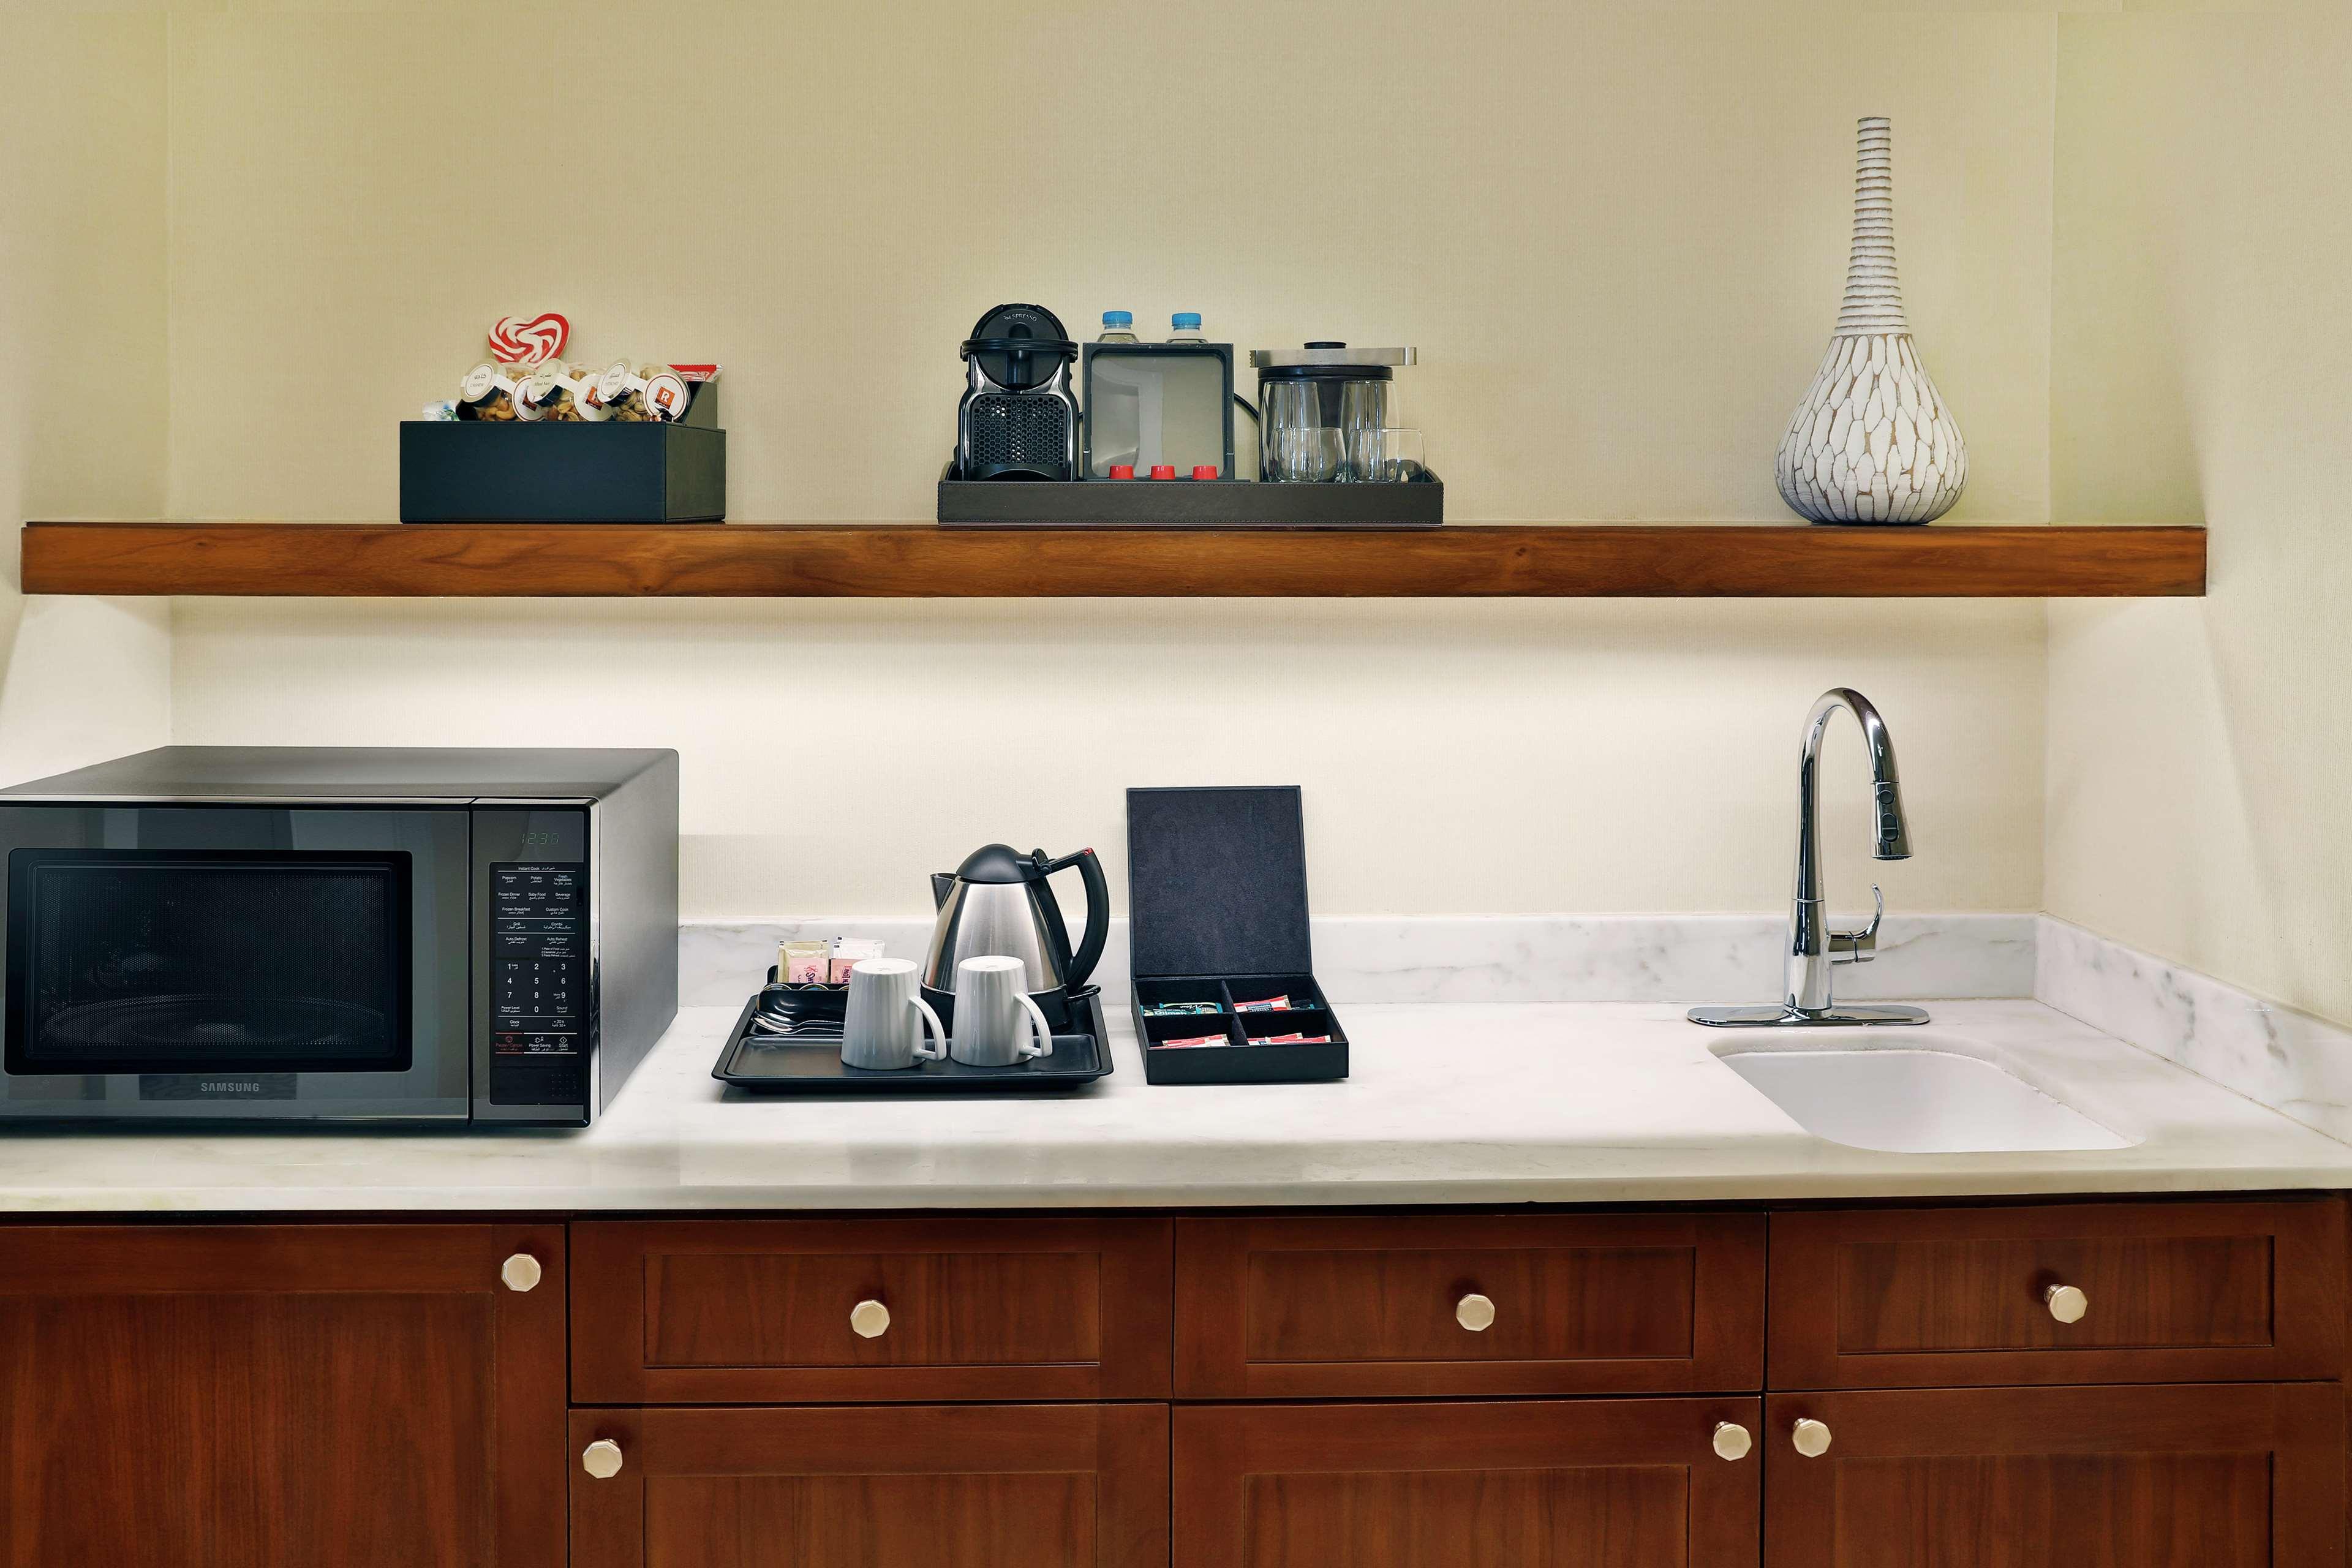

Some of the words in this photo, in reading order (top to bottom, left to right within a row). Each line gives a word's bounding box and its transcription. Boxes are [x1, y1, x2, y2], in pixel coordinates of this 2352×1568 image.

[1003, 313, 1038, 322] NESPRESSO
[662, 390, 670, 402] R
[201, 1082, 260, 1092] SAMSUNG
